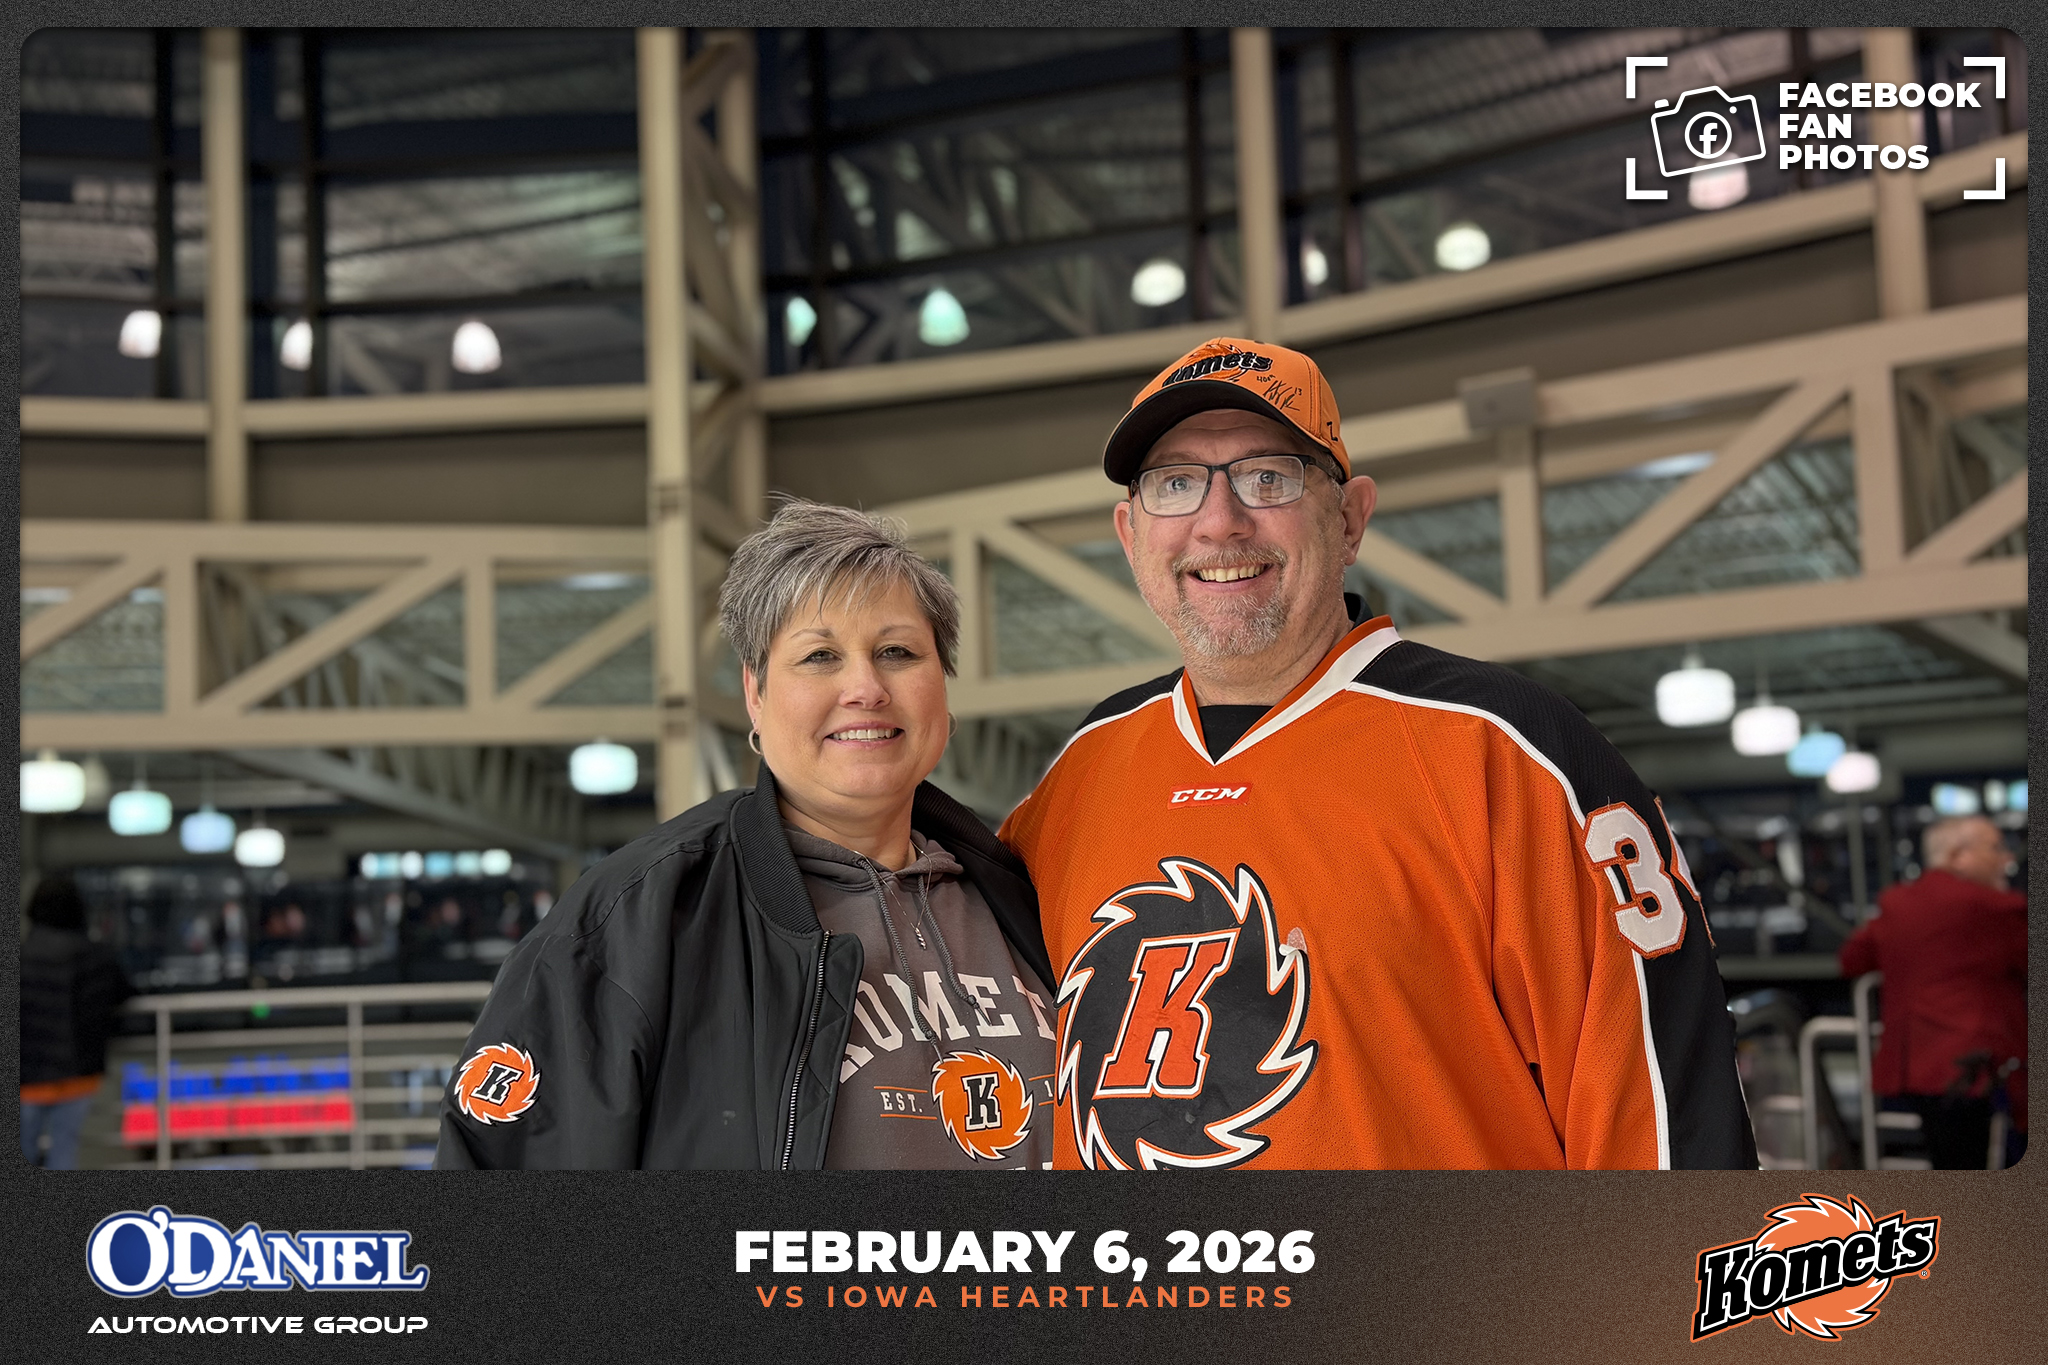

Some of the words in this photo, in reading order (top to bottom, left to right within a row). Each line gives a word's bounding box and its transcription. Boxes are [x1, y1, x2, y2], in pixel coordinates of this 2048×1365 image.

[1170, 786, 1248, 804] CCM
[1582, 798, 1704, 960] 3
[1091, 927, 1242, 1100] K
[468, 1060, 526, 1107] K
[880, 1091, 924, 1113] EST.
[961, 1072, 1003, 1131] K
